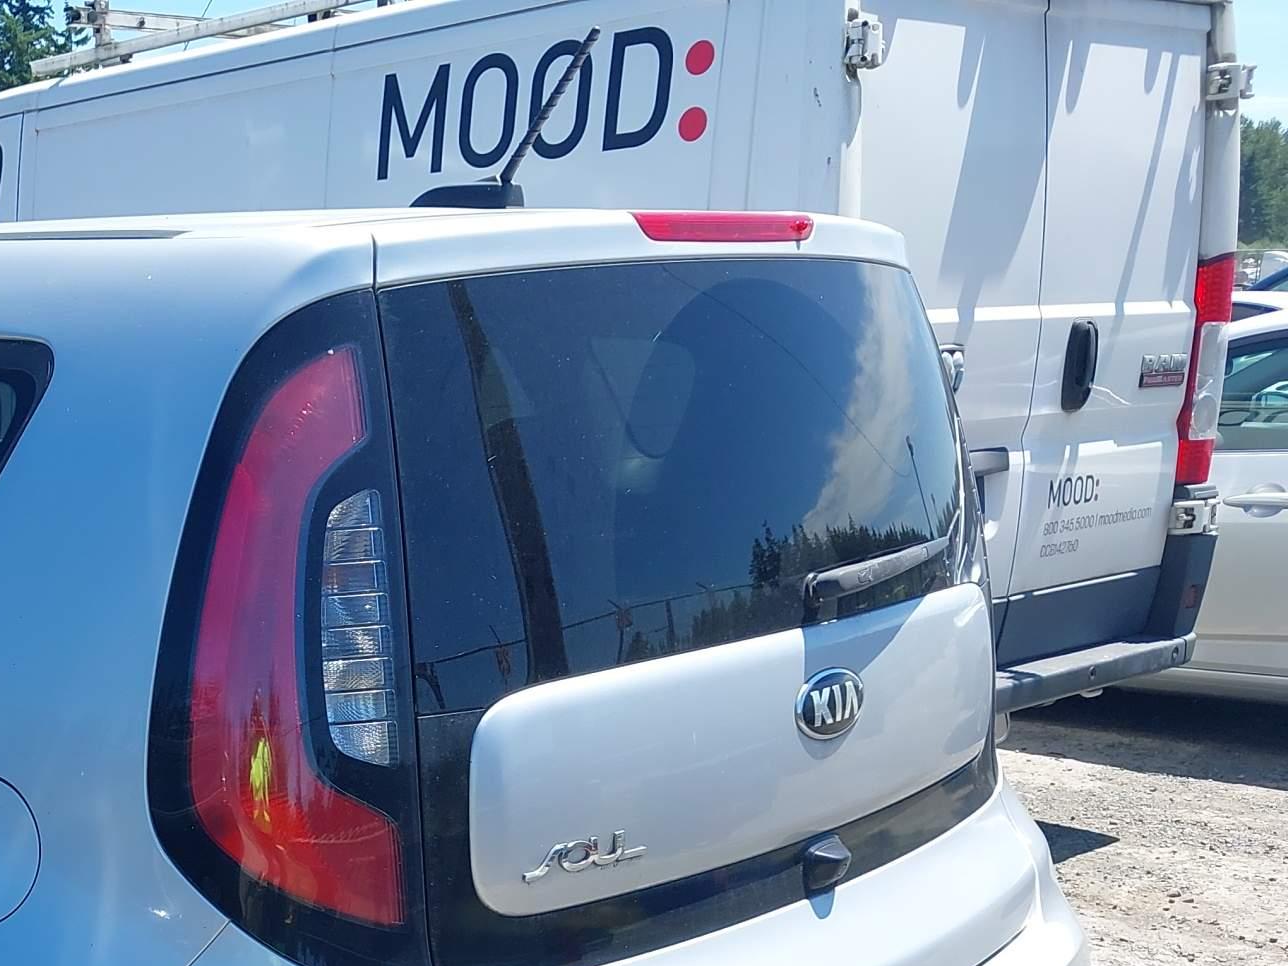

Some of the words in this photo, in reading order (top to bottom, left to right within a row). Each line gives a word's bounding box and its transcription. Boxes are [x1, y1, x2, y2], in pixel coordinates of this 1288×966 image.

[377, 26, 715, 181] MOOD:
[1047, 475, 1100, 510] MOOD:
[1043, 520, 1059, 536] 800
[1059, 518, 1075, 533] 345
[1075, 514, 1094, 531] 5000
[1098, 506, 1152, 527] moodmedia.com
[810, 680, 861, 728] KIA
[522, 829, 647, 883] SOUL
